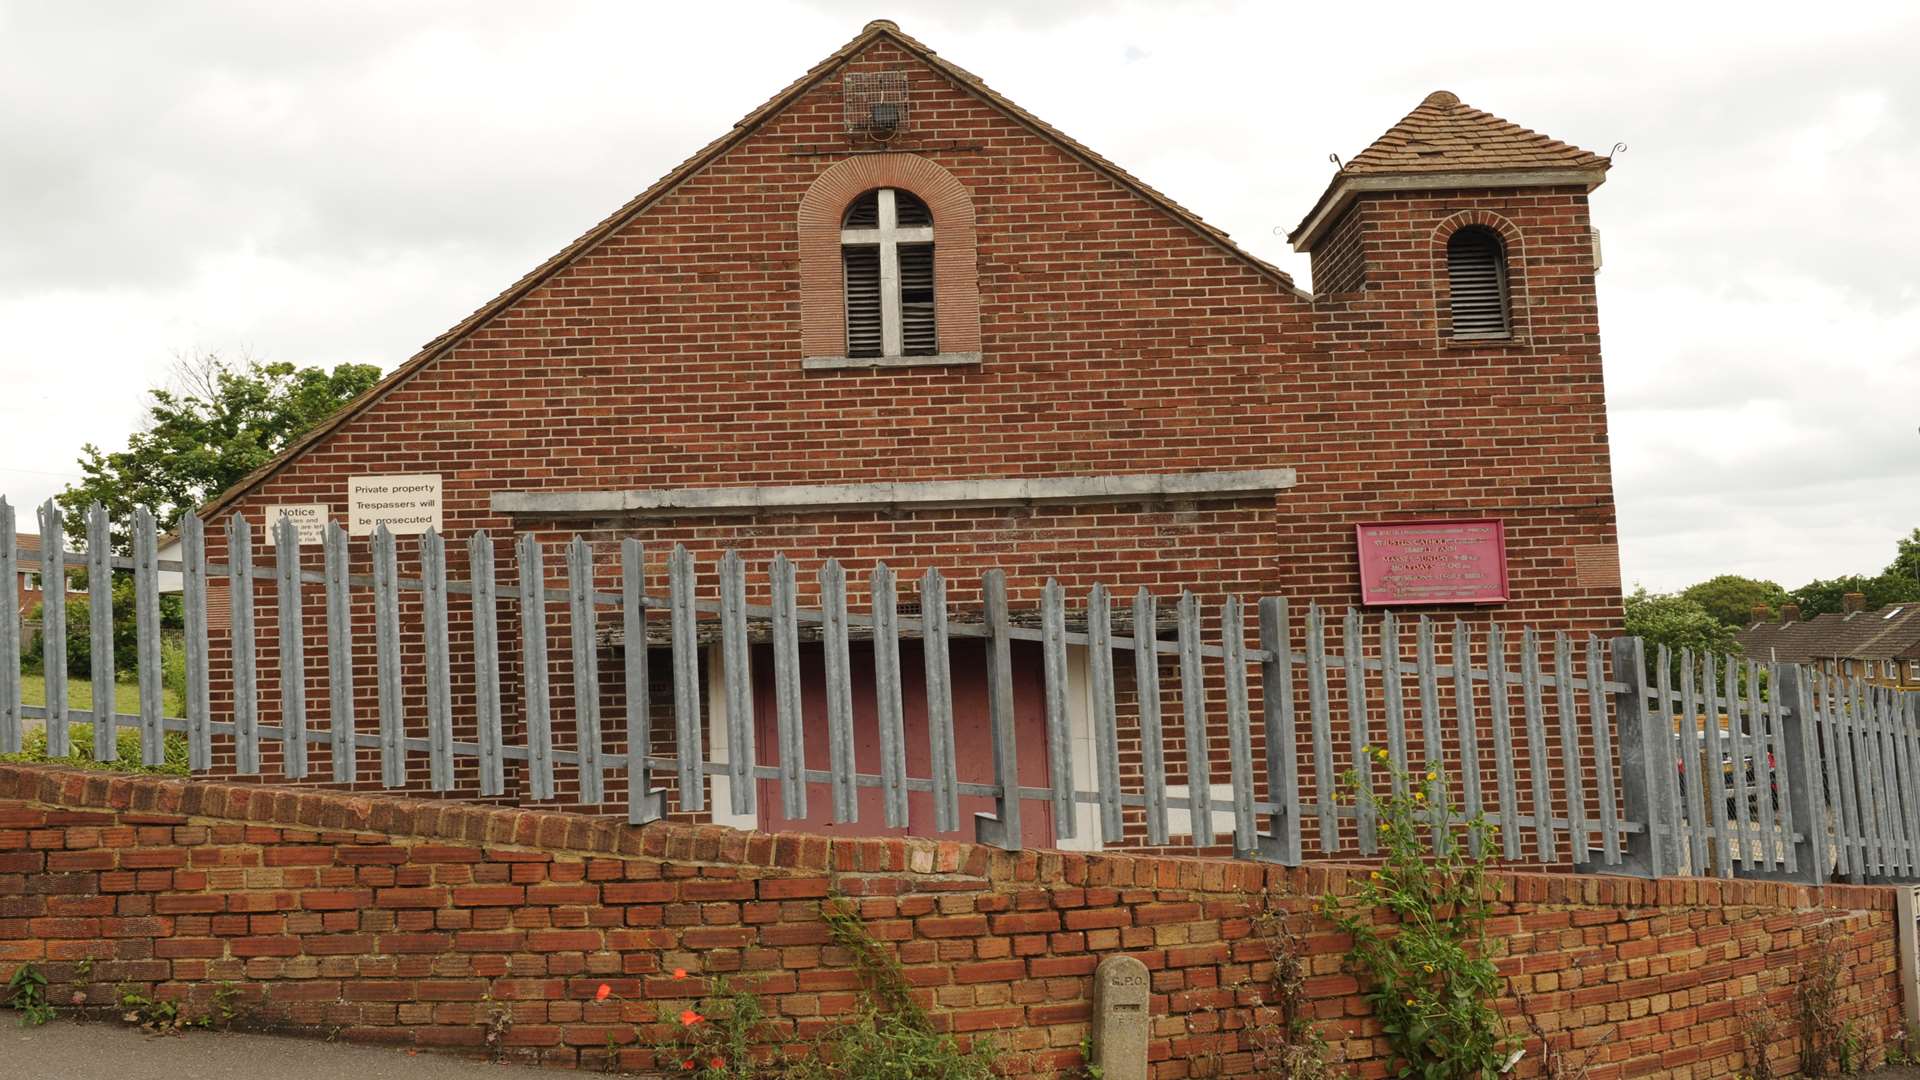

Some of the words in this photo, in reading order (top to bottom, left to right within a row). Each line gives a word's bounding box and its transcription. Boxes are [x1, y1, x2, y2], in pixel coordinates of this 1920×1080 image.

[355, 485, 389, 494] Private
[392, 484, 435, 494] property
[356, 501, 416, 510] Trespassers
[420, 499, 435, 507] will
[279, 507, 315, 516] Notice
[359, 517, 372, 525] be
[375, 515, 433, 525] prosecuted
[1111, 976, 1147, 986] G.P.O.
